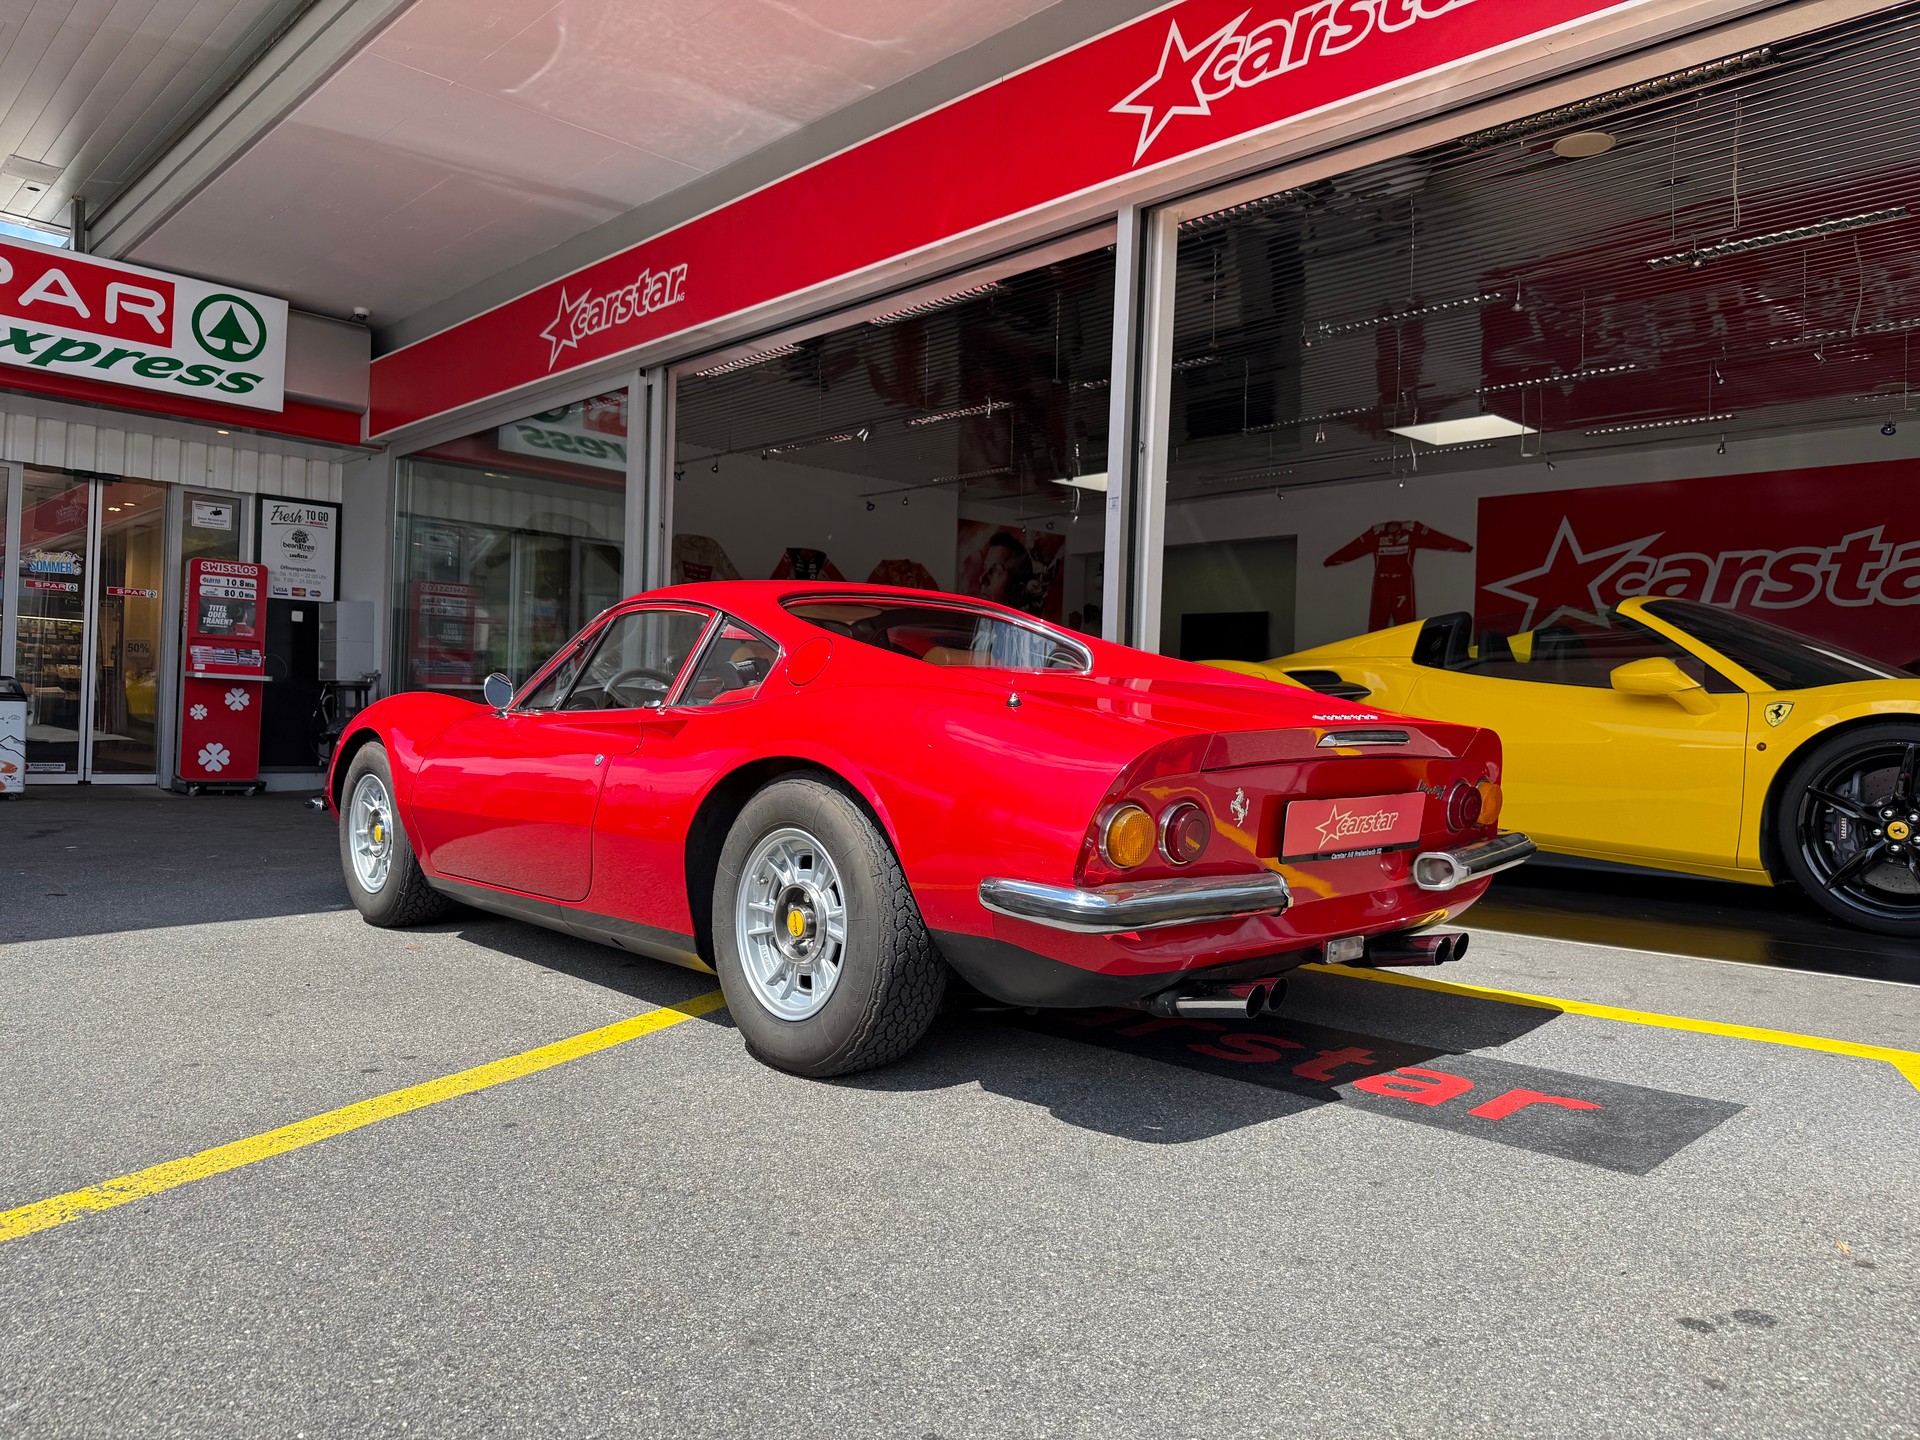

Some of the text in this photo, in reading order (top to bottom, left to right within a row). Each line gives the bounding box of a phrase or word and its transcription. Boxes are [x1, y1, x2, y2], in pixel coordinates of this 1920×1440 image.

[0, 256, 166, 334] AR
[571, 263, 688, 340] carstar
[271, 505, 328, 523] Fresh TO GO
[31, 560, 72, 573] SOMMER
[202, 562, 258, 576] SWISSLOS
[34, 581, 66, 590] SPAR
[116, 588, 146, 596] SPAR
[209, 604, 227, 612] TITEL
[208, 611, 227, 619] ODER
[127, 642, 150, 653] 50%
[1338, 809, 1399, 836] carstar
